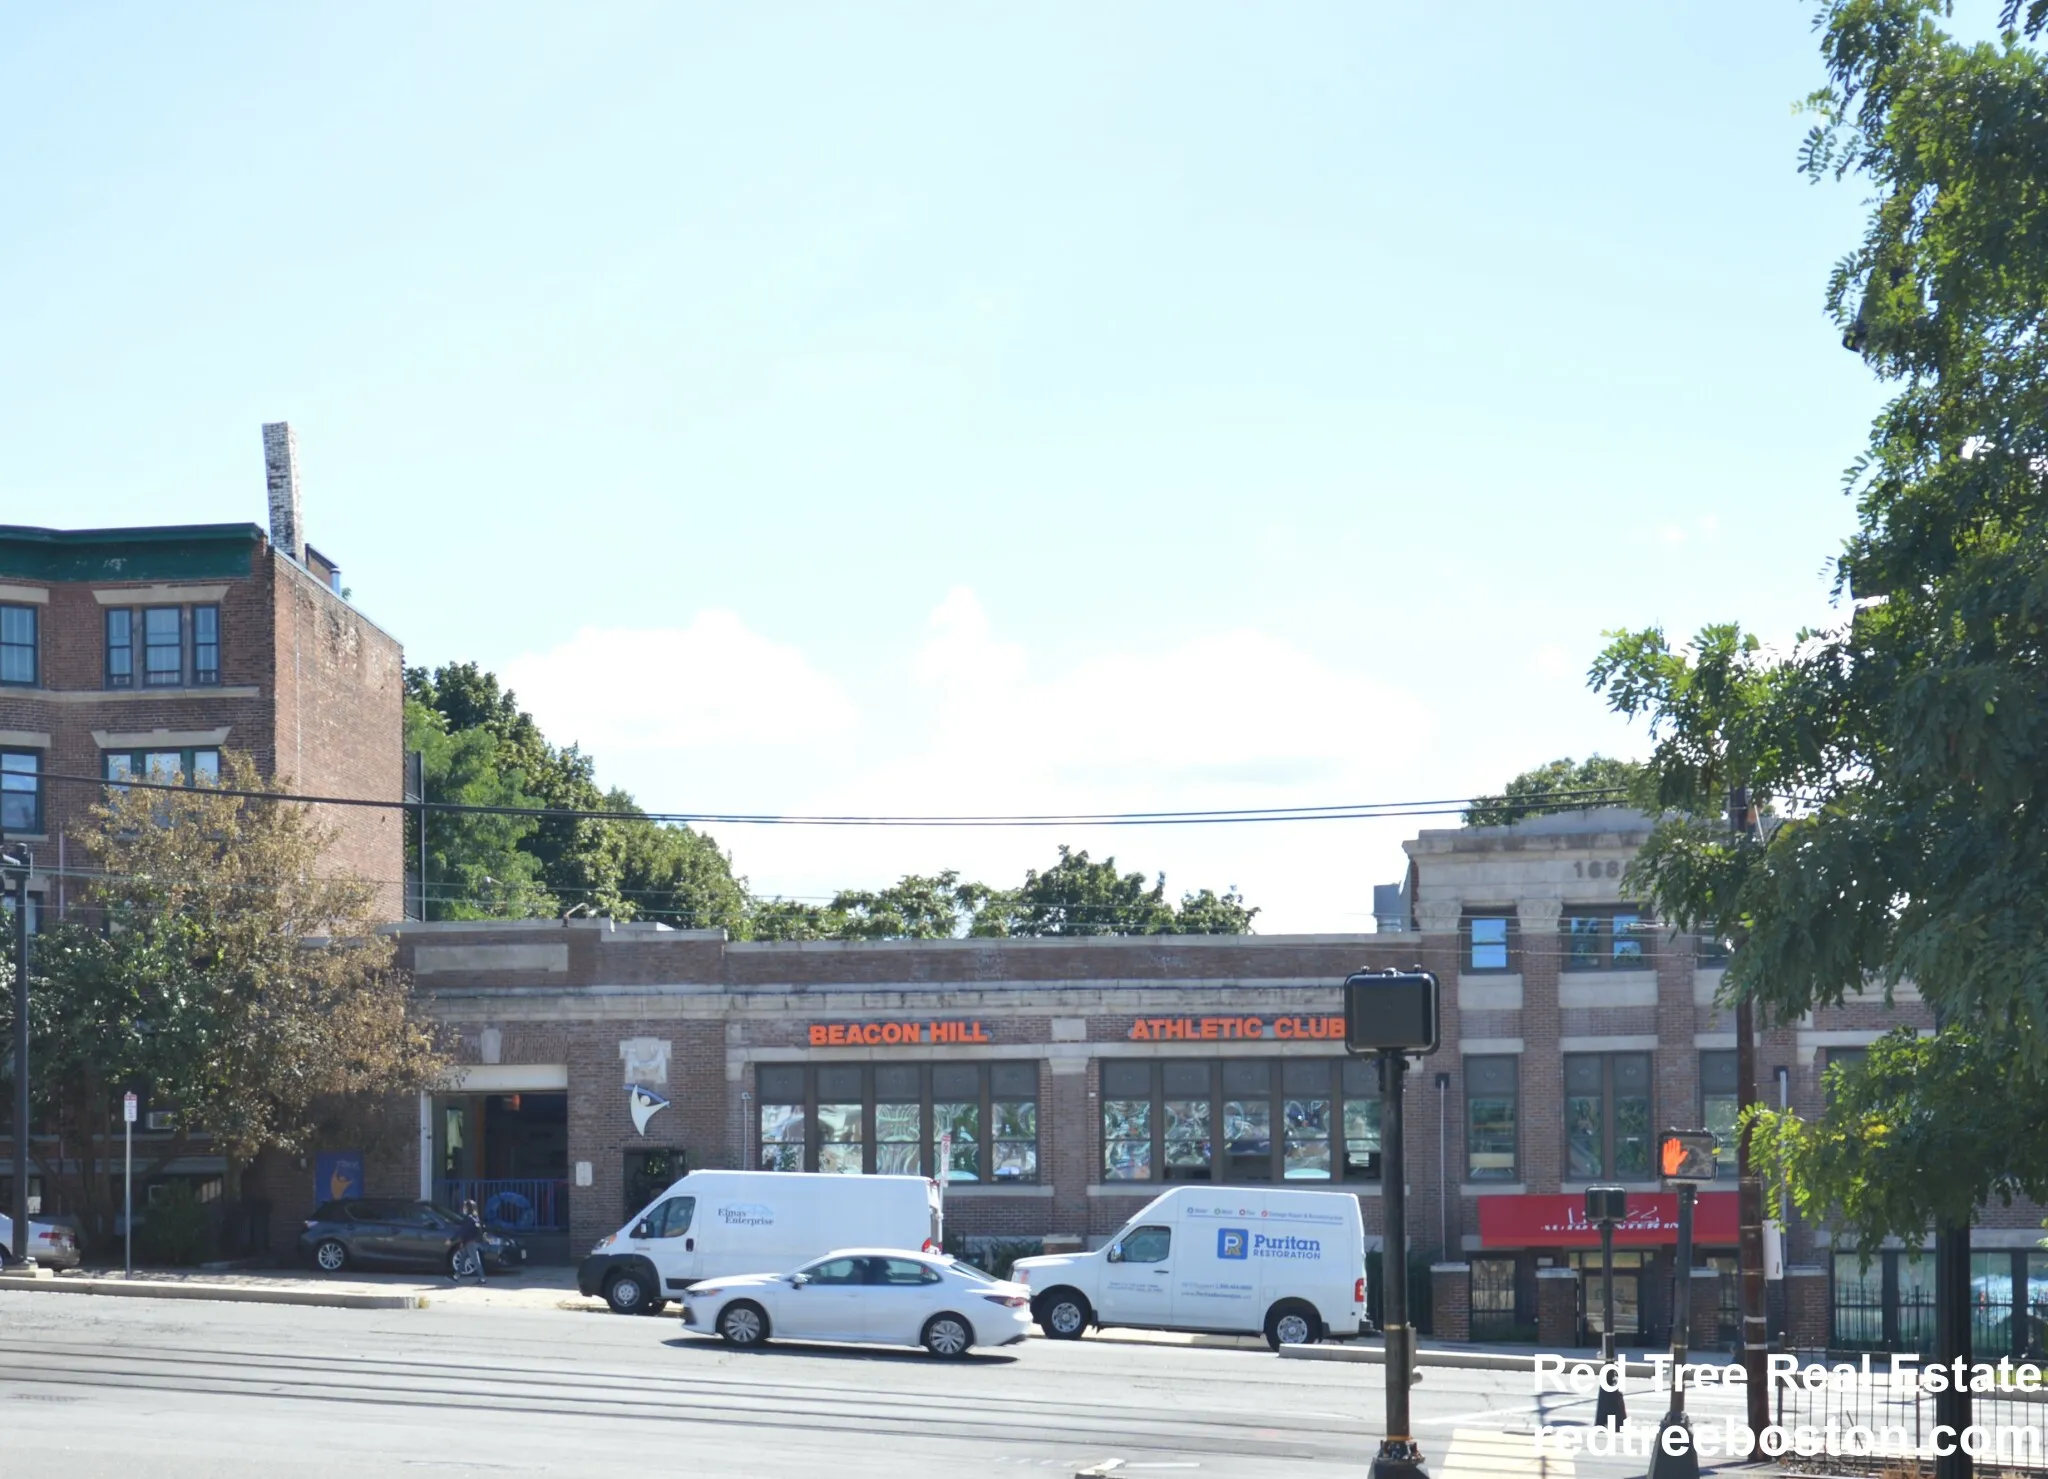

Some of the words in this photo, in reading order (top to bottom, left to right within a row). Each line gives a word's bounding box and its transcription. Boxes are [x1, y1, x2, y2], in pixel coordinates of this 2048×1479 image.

[809, 1023, 920, 1045] BEACON
[930, 1022, 988, 1043] HILL
[1131, 1016, 1263, 1040] ATHLETIC
[1273, 1016, 1346, 1039] CLUB
[725, 1216, 774, 1226] Enterprise
[1254, 1234, 1321, 1251] Puritan
[1253, 1249, 1321, 1259] RESTORATION
